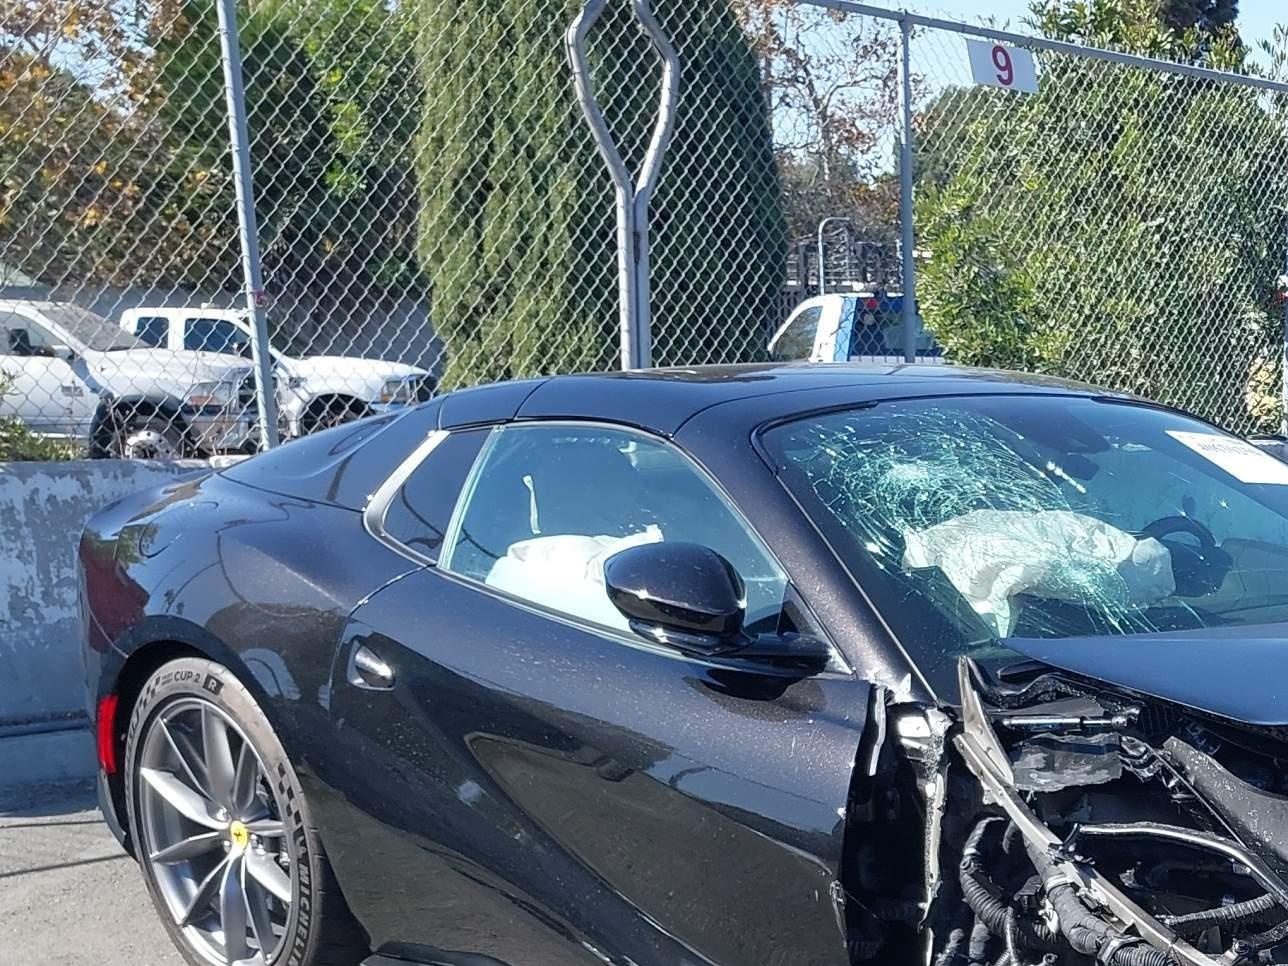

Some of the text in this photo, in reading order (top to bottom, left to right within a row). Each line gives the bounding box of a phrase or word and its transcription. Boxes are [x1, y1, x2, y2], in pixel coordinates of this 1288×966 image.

[991, 45, 1014, 86] 9
[174, 670, 193, 682] CUP
[193, 672, 201, 684] 2
[208, 679, 218, 692] R
